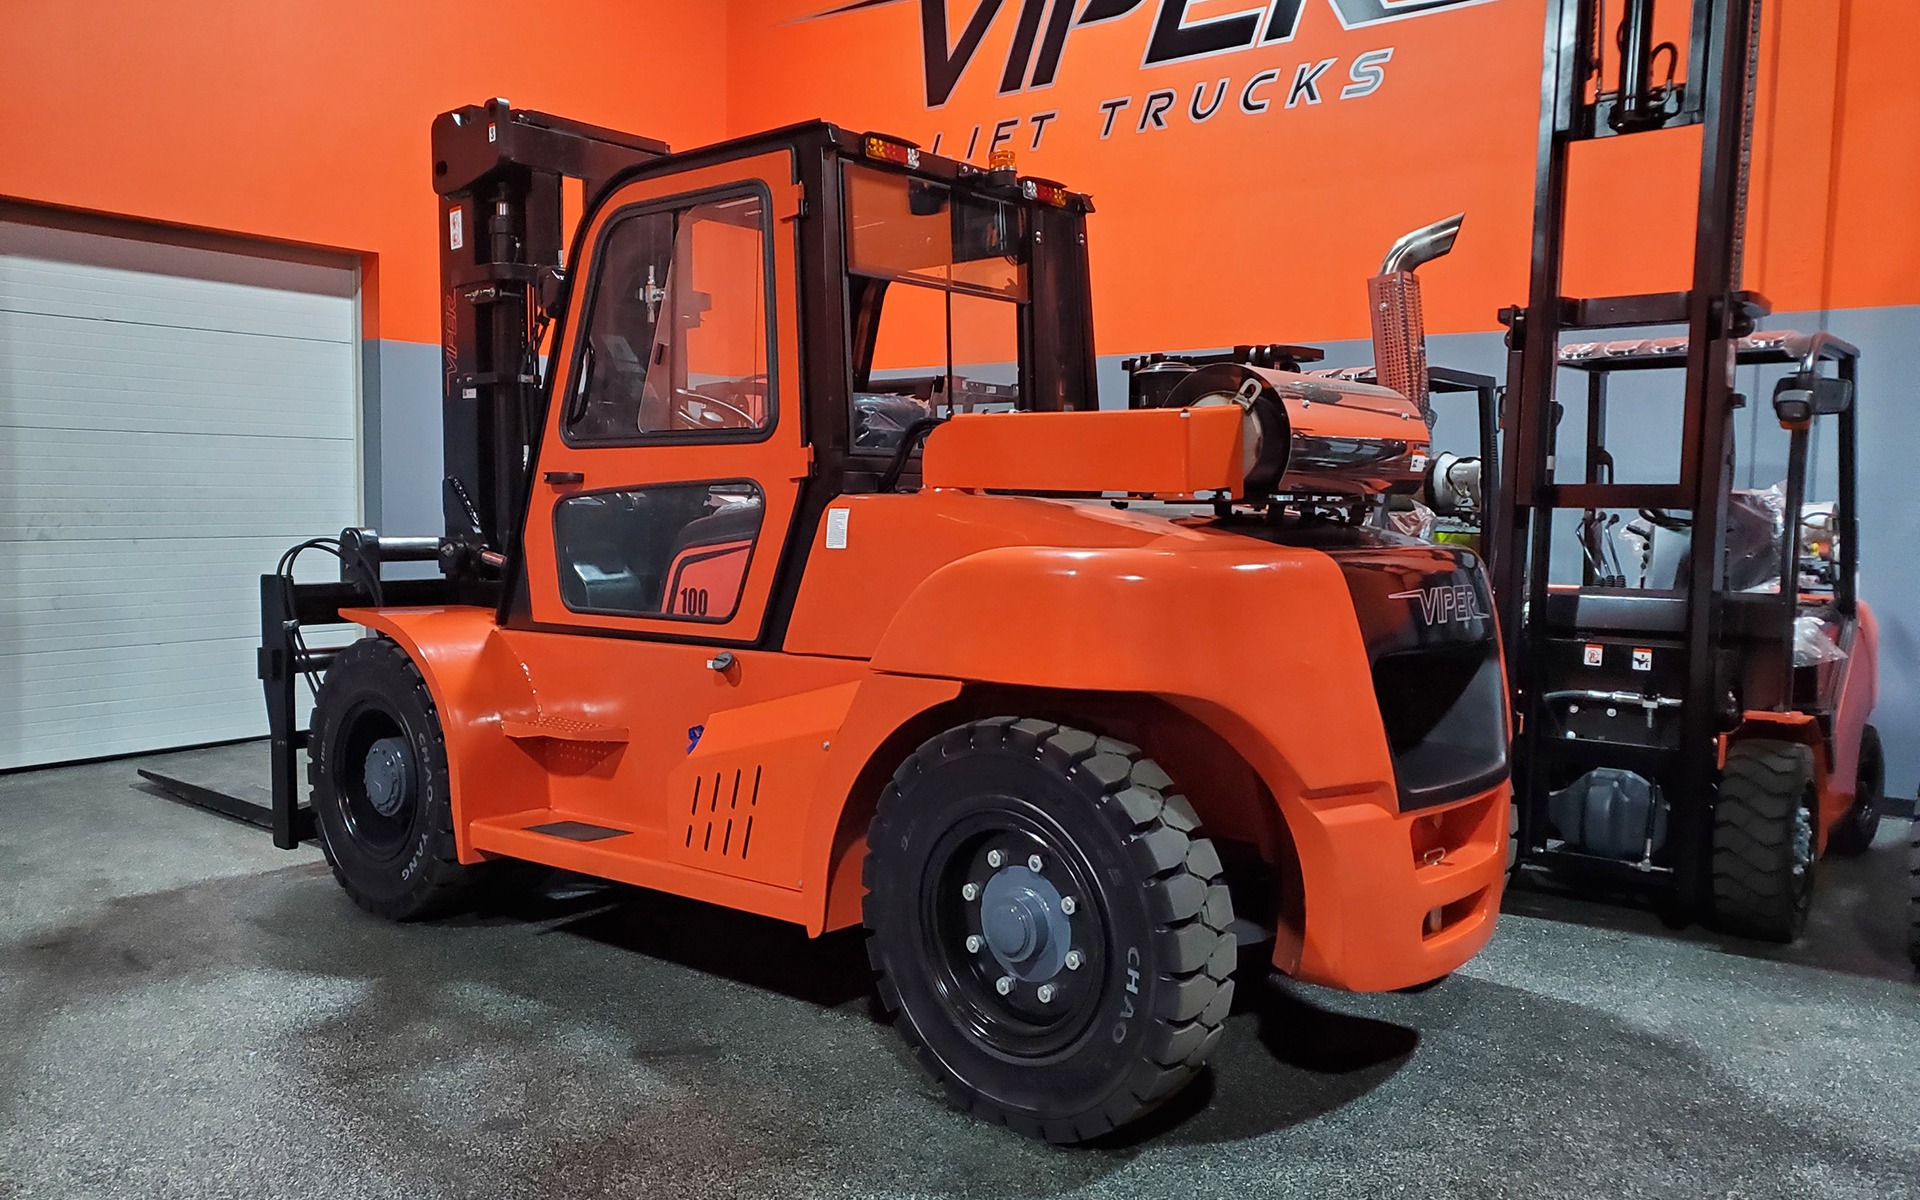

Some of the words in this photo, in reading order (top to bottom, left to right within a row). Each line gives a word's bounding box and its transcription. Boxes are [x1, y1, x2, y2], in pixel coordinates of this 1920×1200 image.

[928, 109, 1062, 162] LIFT
[1099, 47, 1396, 140] TRUCKS
[680, 587, 708, 617] 100
[1387, 583, 1490, 626] VIPER
[418, 732, 433, 803] CHAO
[401, 832, 429, 881] YANG
[1112, 946, 1140, 1044] CHAO
